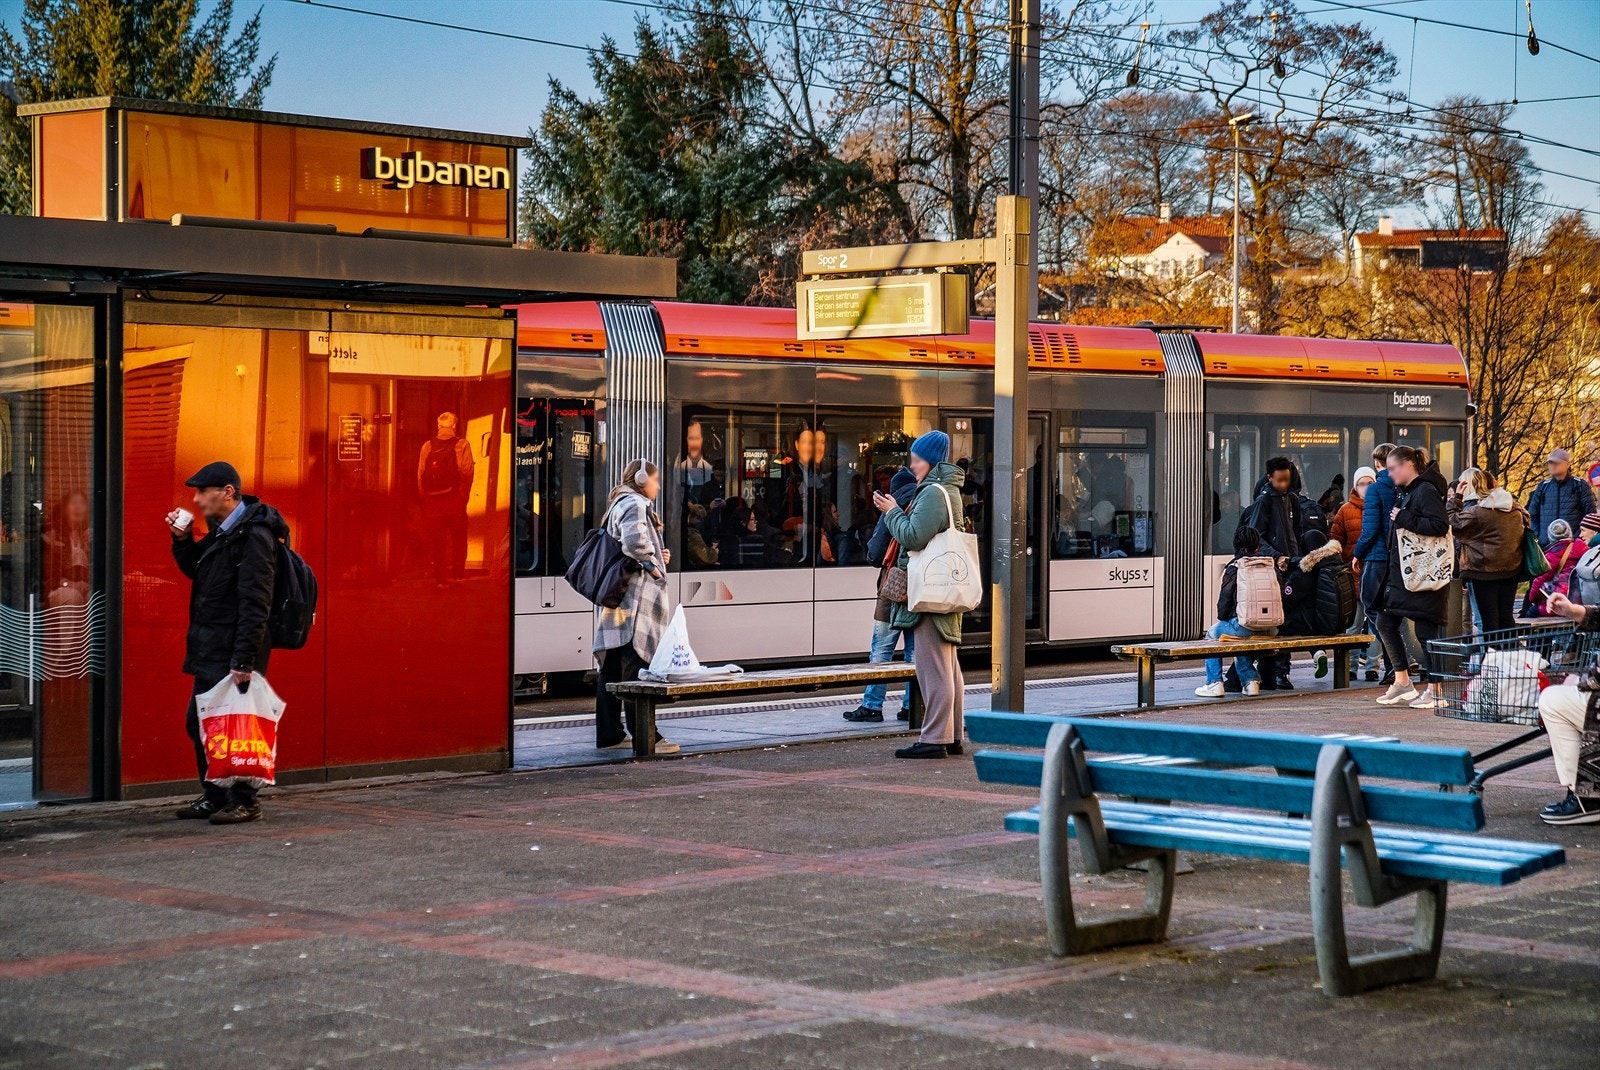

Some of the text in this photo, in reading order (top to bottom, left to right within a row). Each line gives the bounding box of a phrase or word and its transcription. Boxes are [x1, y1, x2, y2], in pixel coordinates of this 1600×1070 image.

[375, 146, 510, 189] bybanen
[817, 254, 848, 269] Spor 2
[835, 292, 859, 300] sentrum
[836, 301, 860, 309] sentrum
[836, 310, 860, 319] sentrum
[1393, 391, 1431, 408] bybanen
[1109, 567, 1141, 584] skyss
